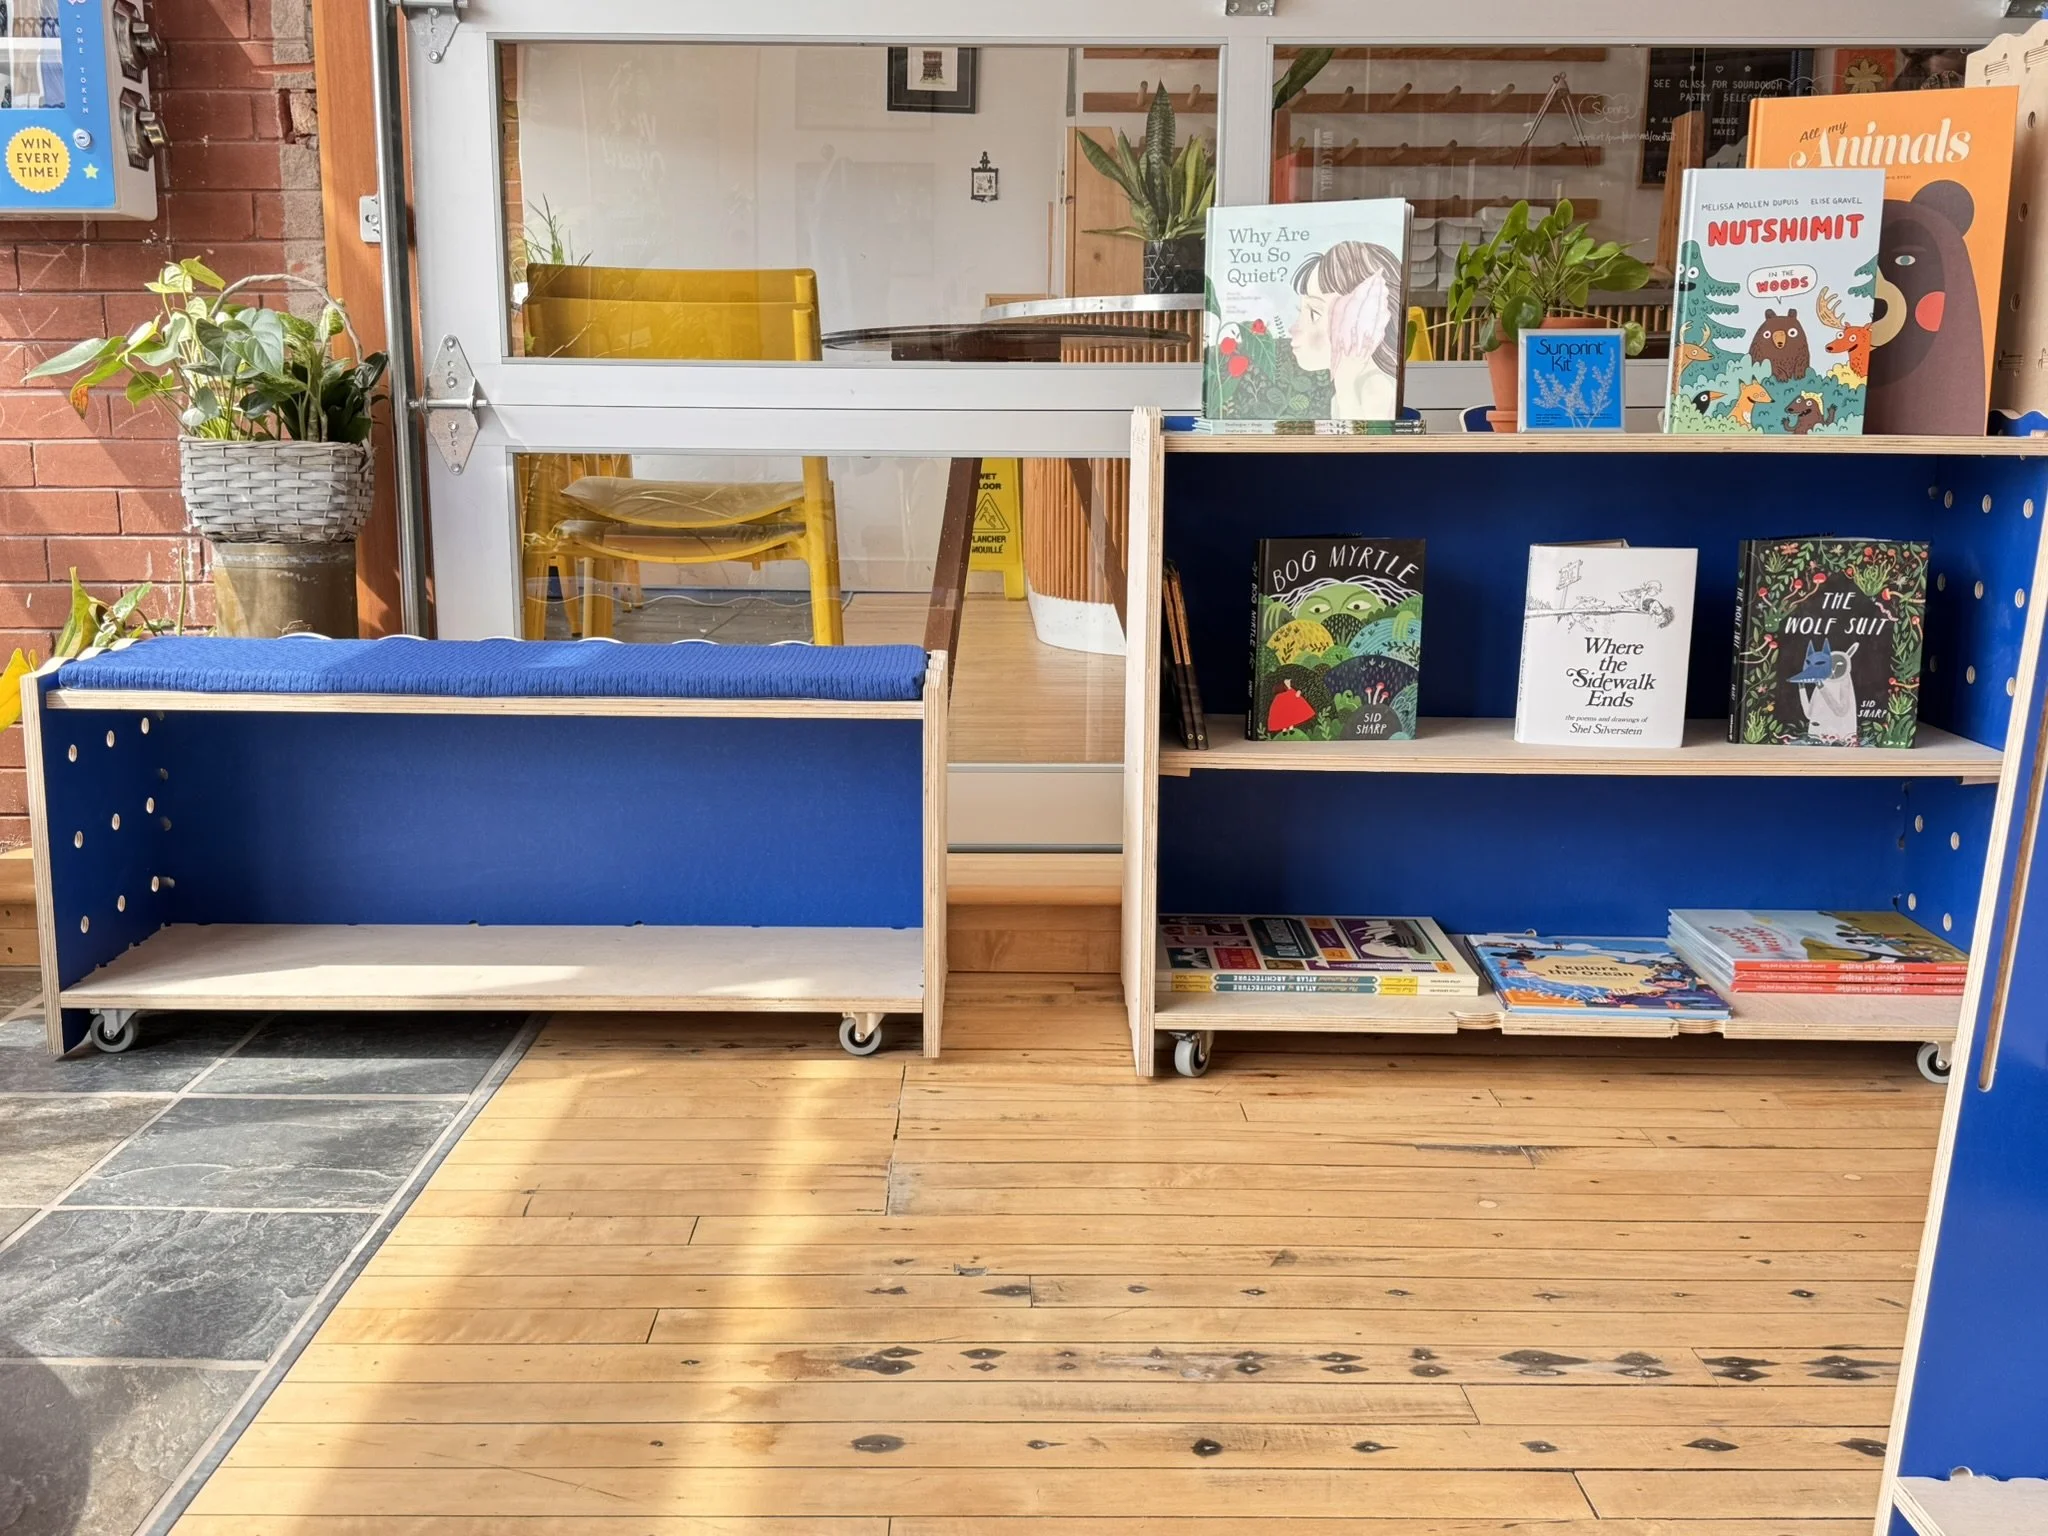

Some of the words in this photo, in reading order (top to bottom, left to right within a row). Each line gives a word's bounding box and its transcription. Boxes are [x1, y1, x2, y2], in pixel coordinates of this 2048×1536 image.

[76, 27, 85, 54] ONE
[80, 67, 89, 114] TOKEN
[1653, 79, 1671, 88] SEE
[1679, 80, 1706, 89] GLASS
[1712, 80, 1728, 89] FOR
[1732, 80, 1783, 90] SOURDOUGH
[1680, 92, 1712, 102] PASTRY
[1712, 117, 1739, 125] INCLUDE
[1800, 128, 1821, 144] All
[1827, 121, 1848, 135] my
[21, 138, 52, 149] WIN
[1788, 117, 1972, 169] Animals
[16, 153, 59, 164] EVERY
[19, 167, 59, 178] TIME!
[1701, 203, 1735, 211] MELISSA
[1737, 201, 1769, 209] MOLLEN
[1832, 197, 1862, 205] GRAVEL
[1228, 228, 1272, 247] Why
[1276, 226, 1310, 243] Are
[1707, 213, 1865, 247] NUTSHIMIT
[1228, 248, 1262, 264] You
[1267, 248, 1291, 262] So
[1227, 266, 1288, 287] Quiet?
[1756, 276, 1809, 293] WOODS
[1552, 355, 1573, 372] Kit
[973, 535, 1007, 544] LANCHER
[1272, 550, 1317, 593] BOG
[1329, 544, 1420, 585] MYRTLE
[1822, 592, 1856, 610] THE
[1784, 617, 1838, 635] WOLF
[1844, 617, 1889, 635] SUIT
[1584, 637, 1644, 655] Where
[1599, 656, 1628, 674] the
[1566, 668, 1656, 691] Sidewalk
[1585, 690, 1634, 708] Ends
[1860, 700, 1875, 708] SID
[1363, 712, 1382, 723] SID
[1857, 709, 1888, 718] SHARP
[1355, 724, 1387, 735] SHARP
[1569, 722, 1592, 734] Shel
[1593, 723, 1643, 735] Silverstein
